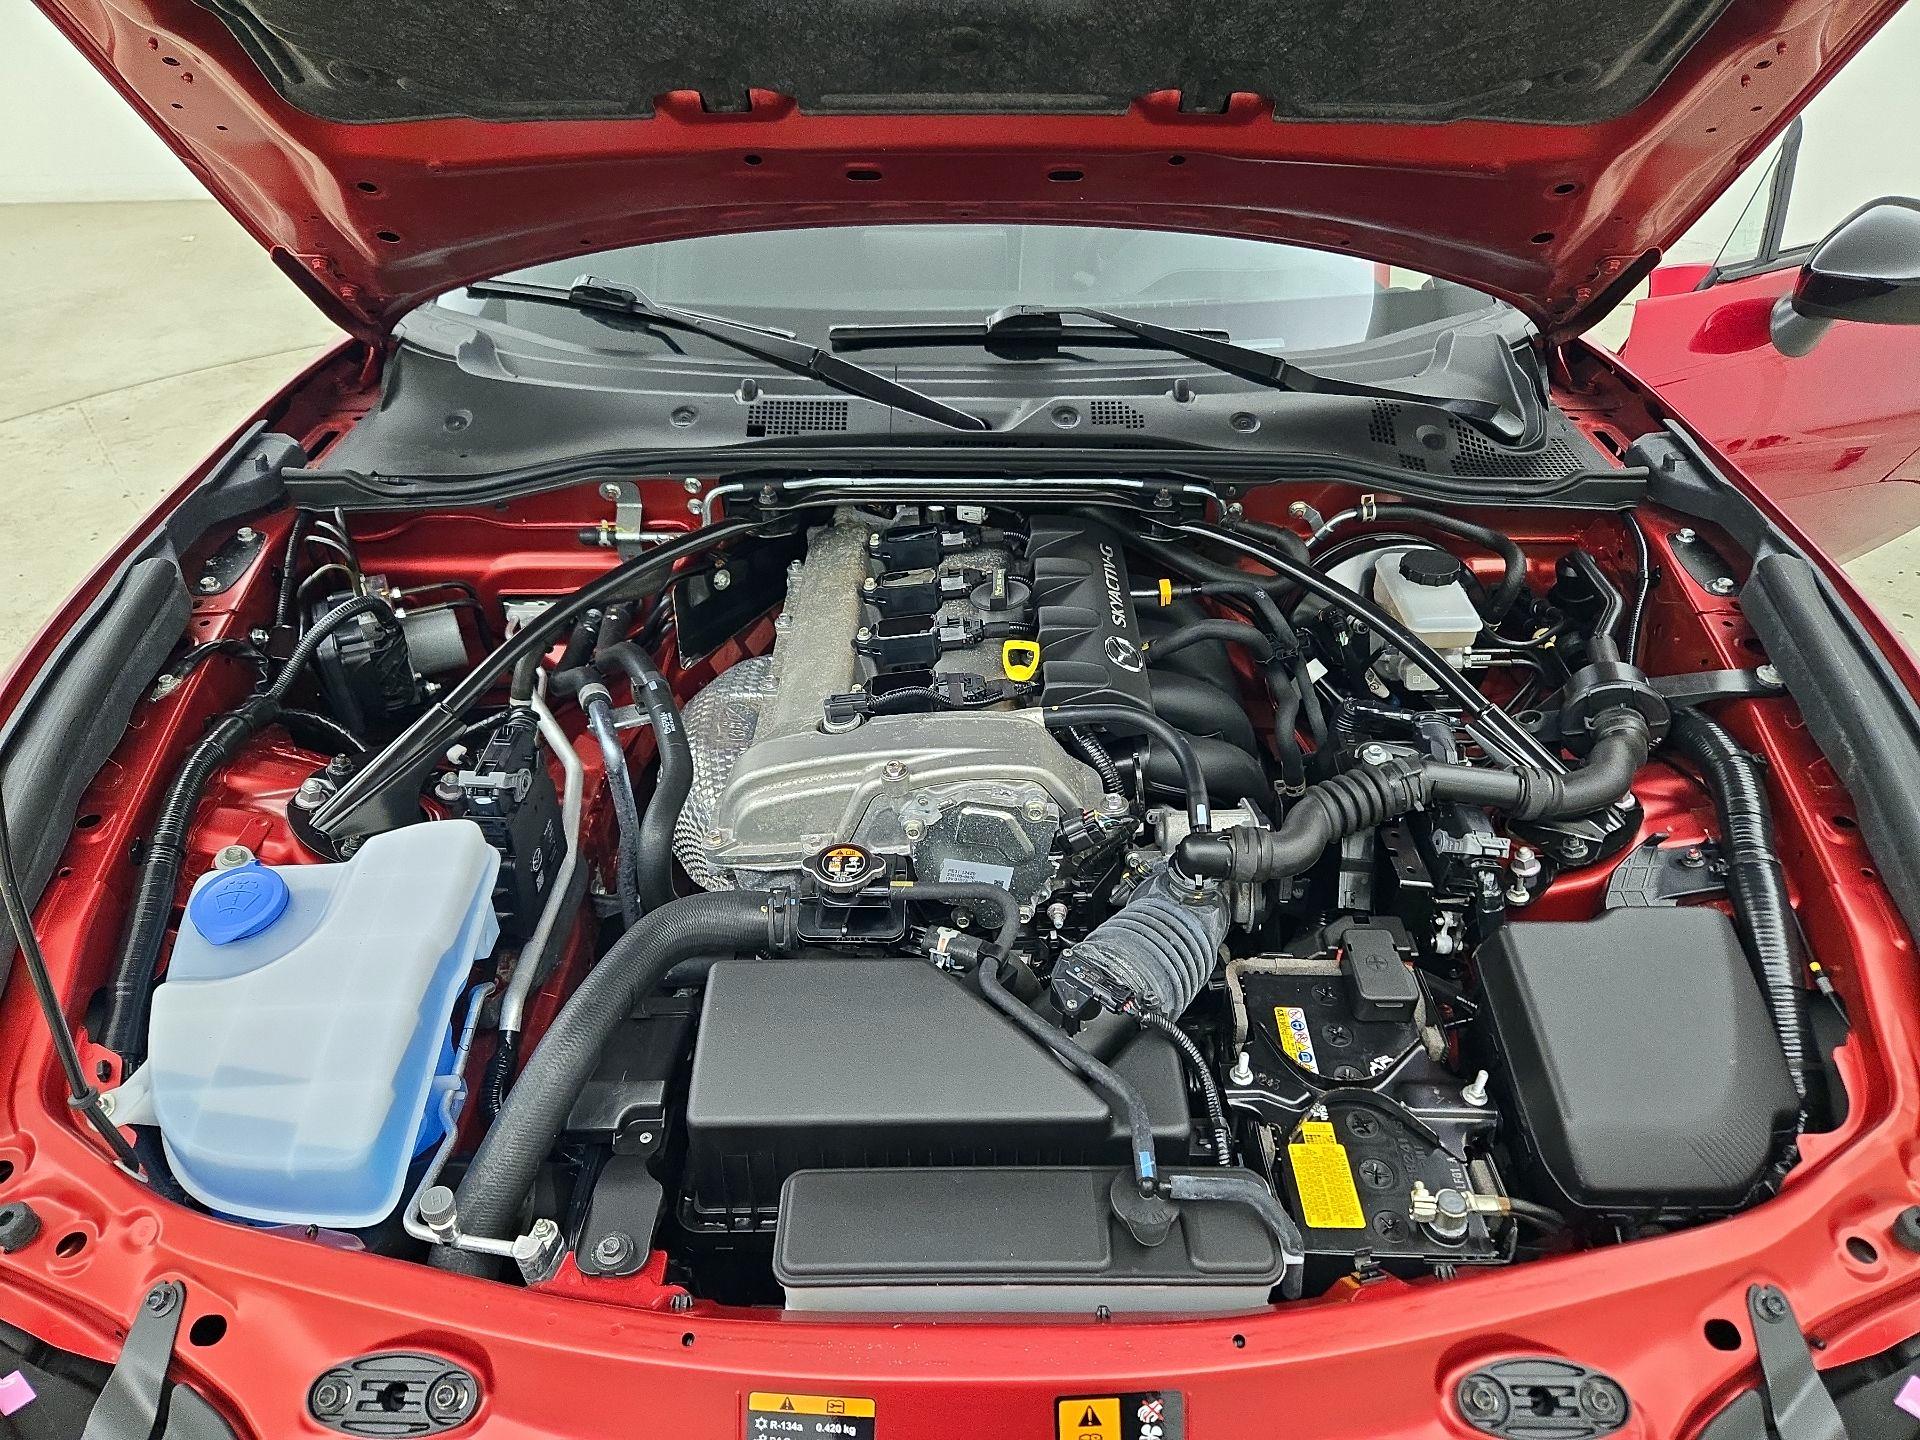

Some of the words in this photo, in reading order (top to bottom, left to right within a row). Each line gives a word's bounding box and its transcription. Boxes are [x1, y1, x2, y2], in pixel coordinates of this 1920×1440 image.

[1100, 543, 1126, 628] SKYACTIV-G
[769, 1420, 804, 1432] R-134a
[815, 1423, 842, 1434] 0.420
[843, 1423, 857, 1437] kg
